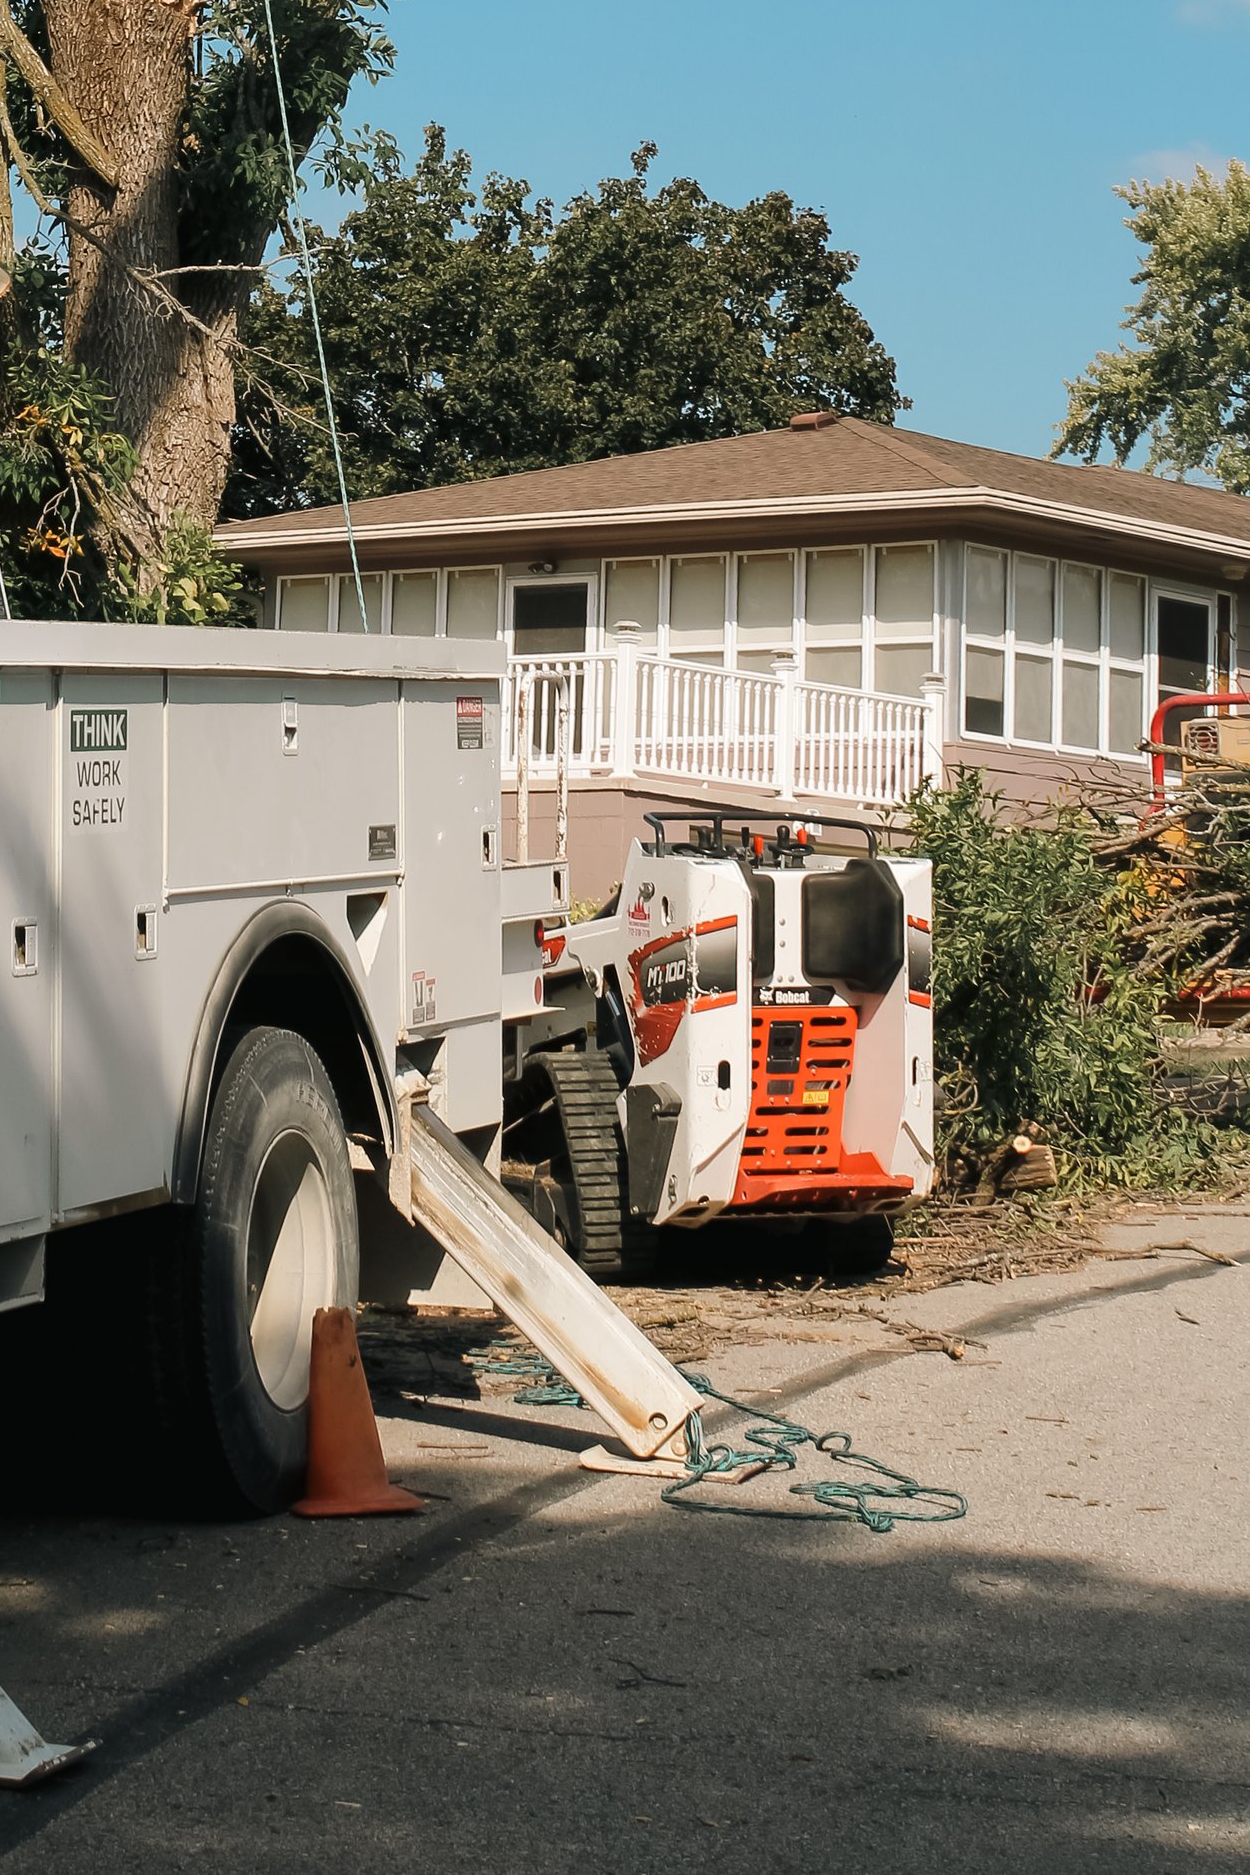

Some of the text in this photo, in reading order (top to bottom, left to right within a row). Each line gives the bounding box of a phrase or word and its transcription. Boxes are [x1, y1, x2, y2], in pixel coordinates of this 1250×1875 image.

[72, 713, 126, 748] THINK
[76, 759, 121, 787] WORK
[72, 797, 125, 826] SAFELY
[775, 990, 811, 1005] Bobcat
